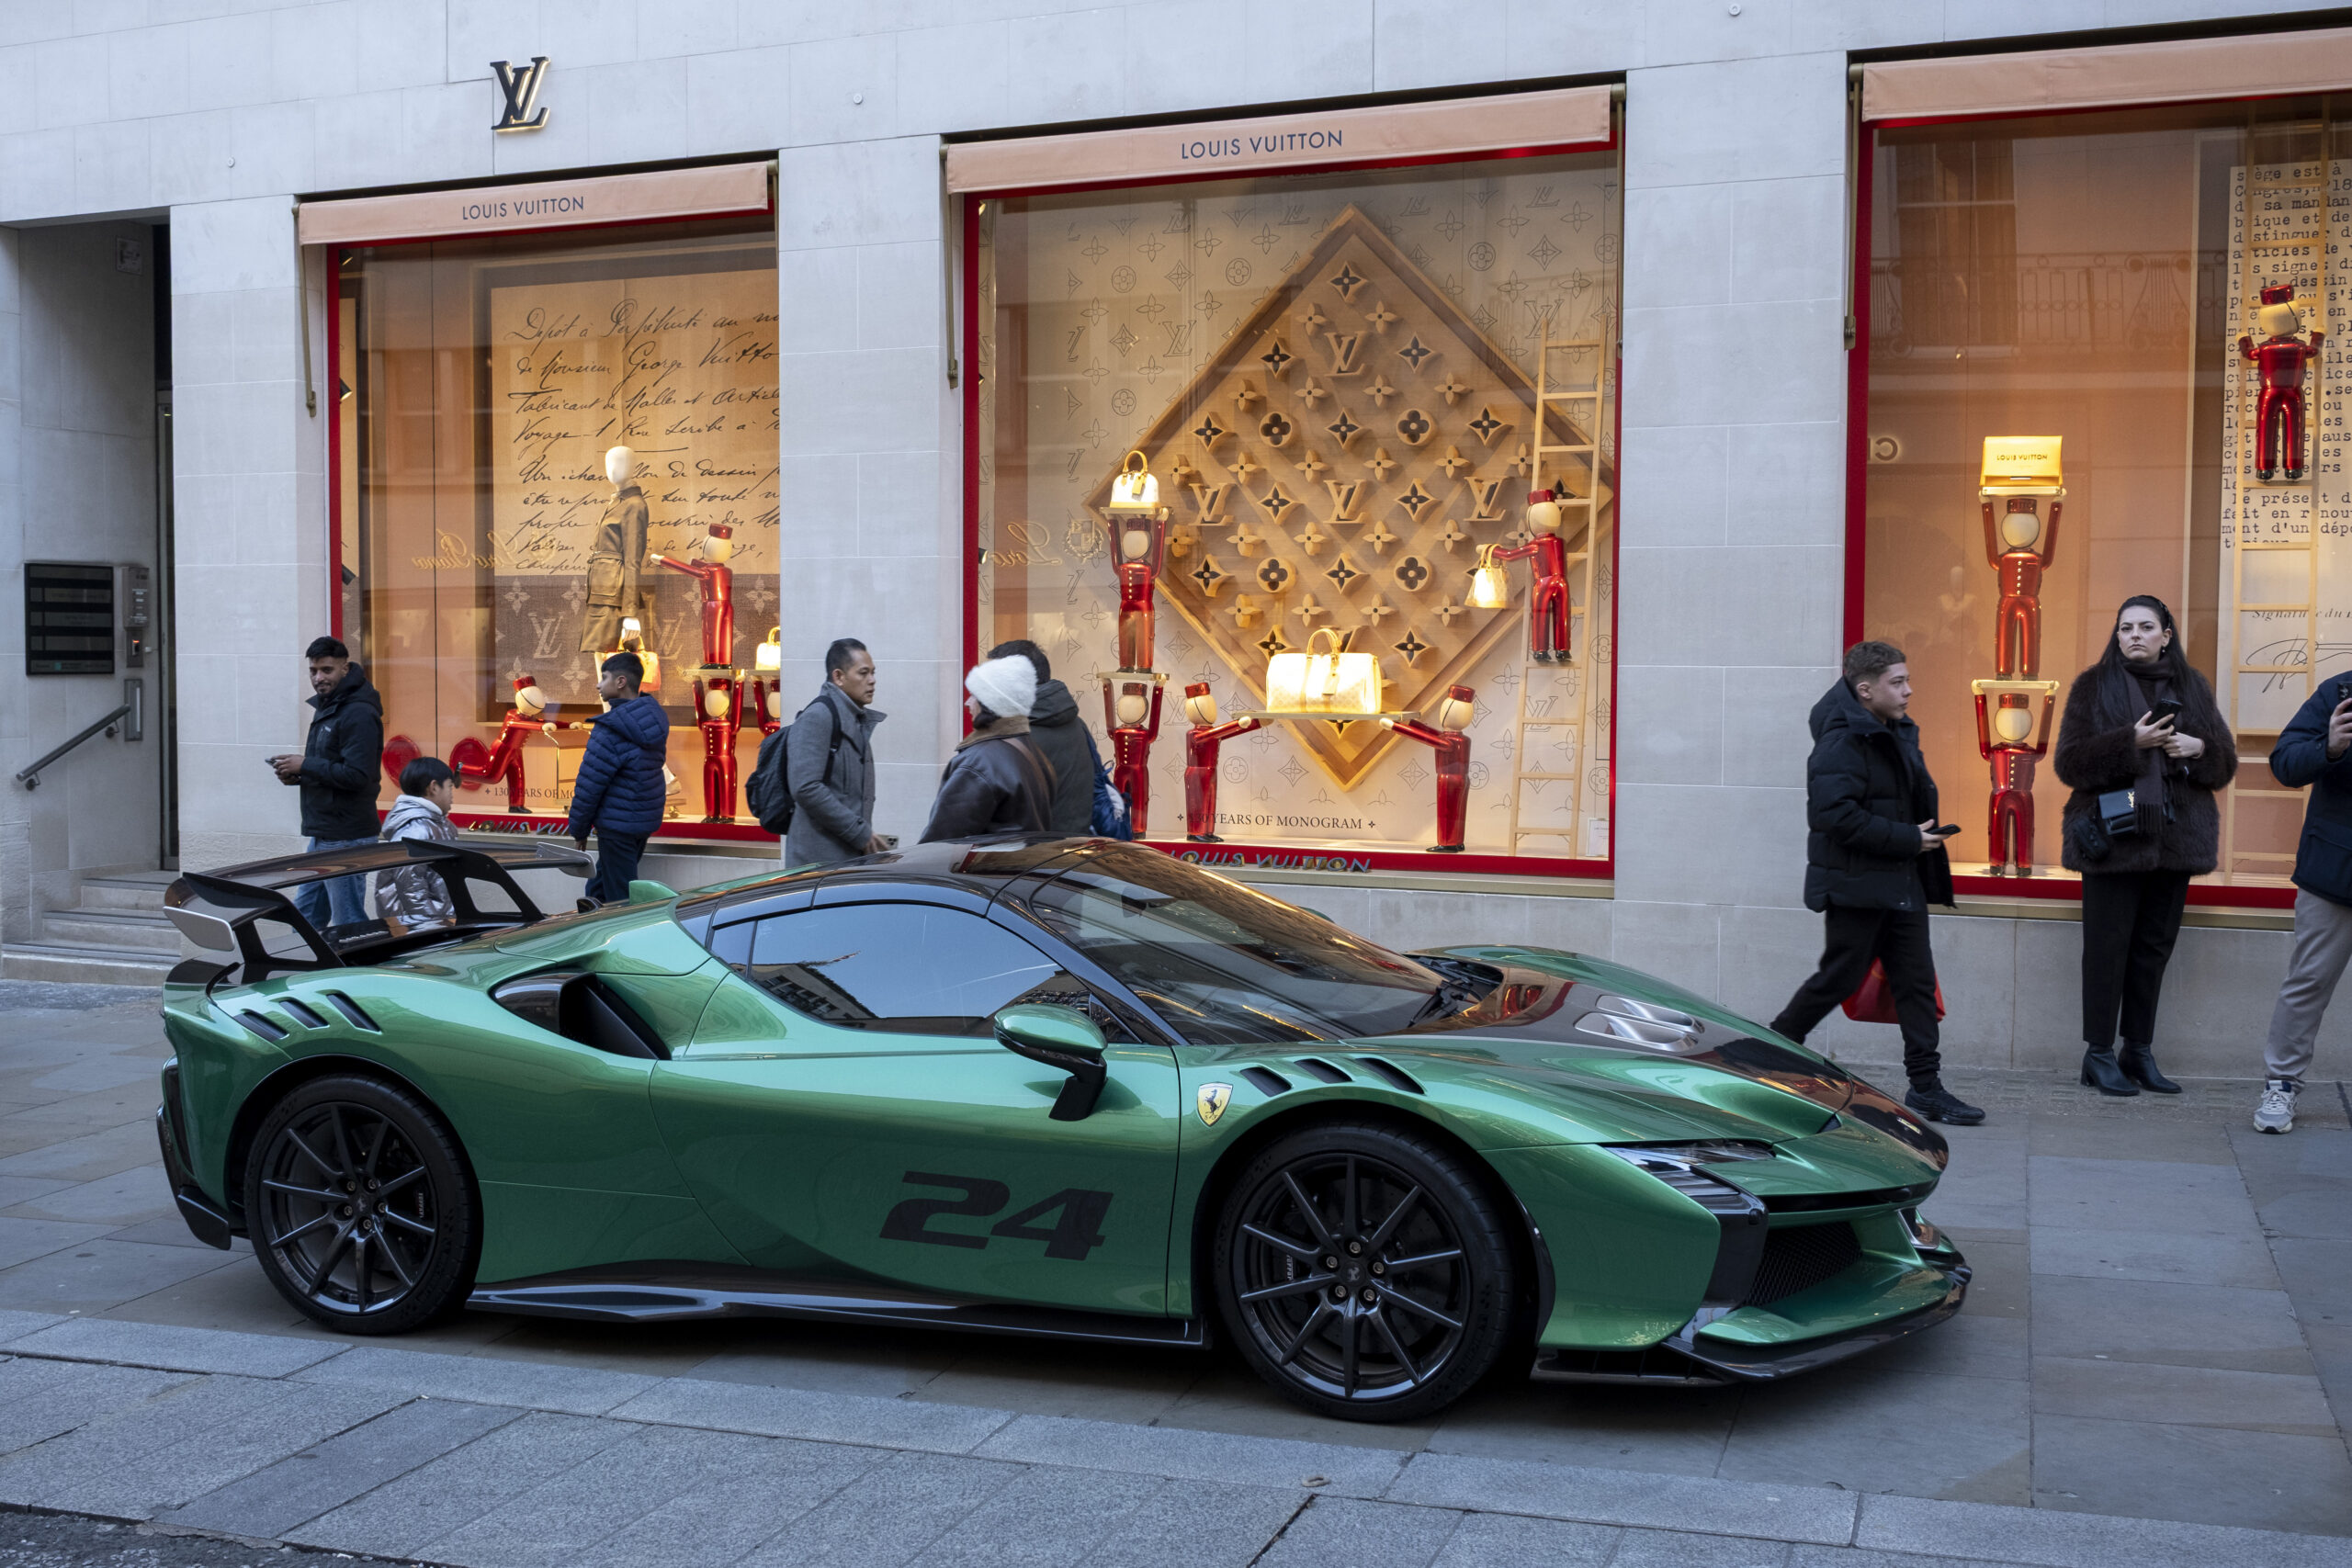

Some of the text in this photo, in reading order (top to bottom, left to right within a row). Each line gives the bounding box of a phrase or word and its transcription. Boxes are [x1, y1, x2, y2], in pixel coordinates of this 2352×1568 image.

[1182, 130, 1342, 159] LOUIS VUITTON
[2293, 165, 2321, 178] est
[2332, 162, 2342, 175] à
[462, 196, 584, 220] LOUIS VUITTON
[2264, 201, 2282, 210] sa
[2301, 212, 2321, 224] et
[2331, 210, 2350, 222] de
[2327, 307, 2346, 317] en
[2323, 401, 2343, 411] ou
[2271, 510, 2290, 518] en
[2271, 523, 2310, 534] d'un
[1213, 813, 1252, 825] YEARS
[1255, 815, 1273, 826] OF
[1276, 816, 1363, 829] MONOGRAM
[1255, 854, 1372, 873] VUITTON
[879, 1170, 1114, 1261] 24
